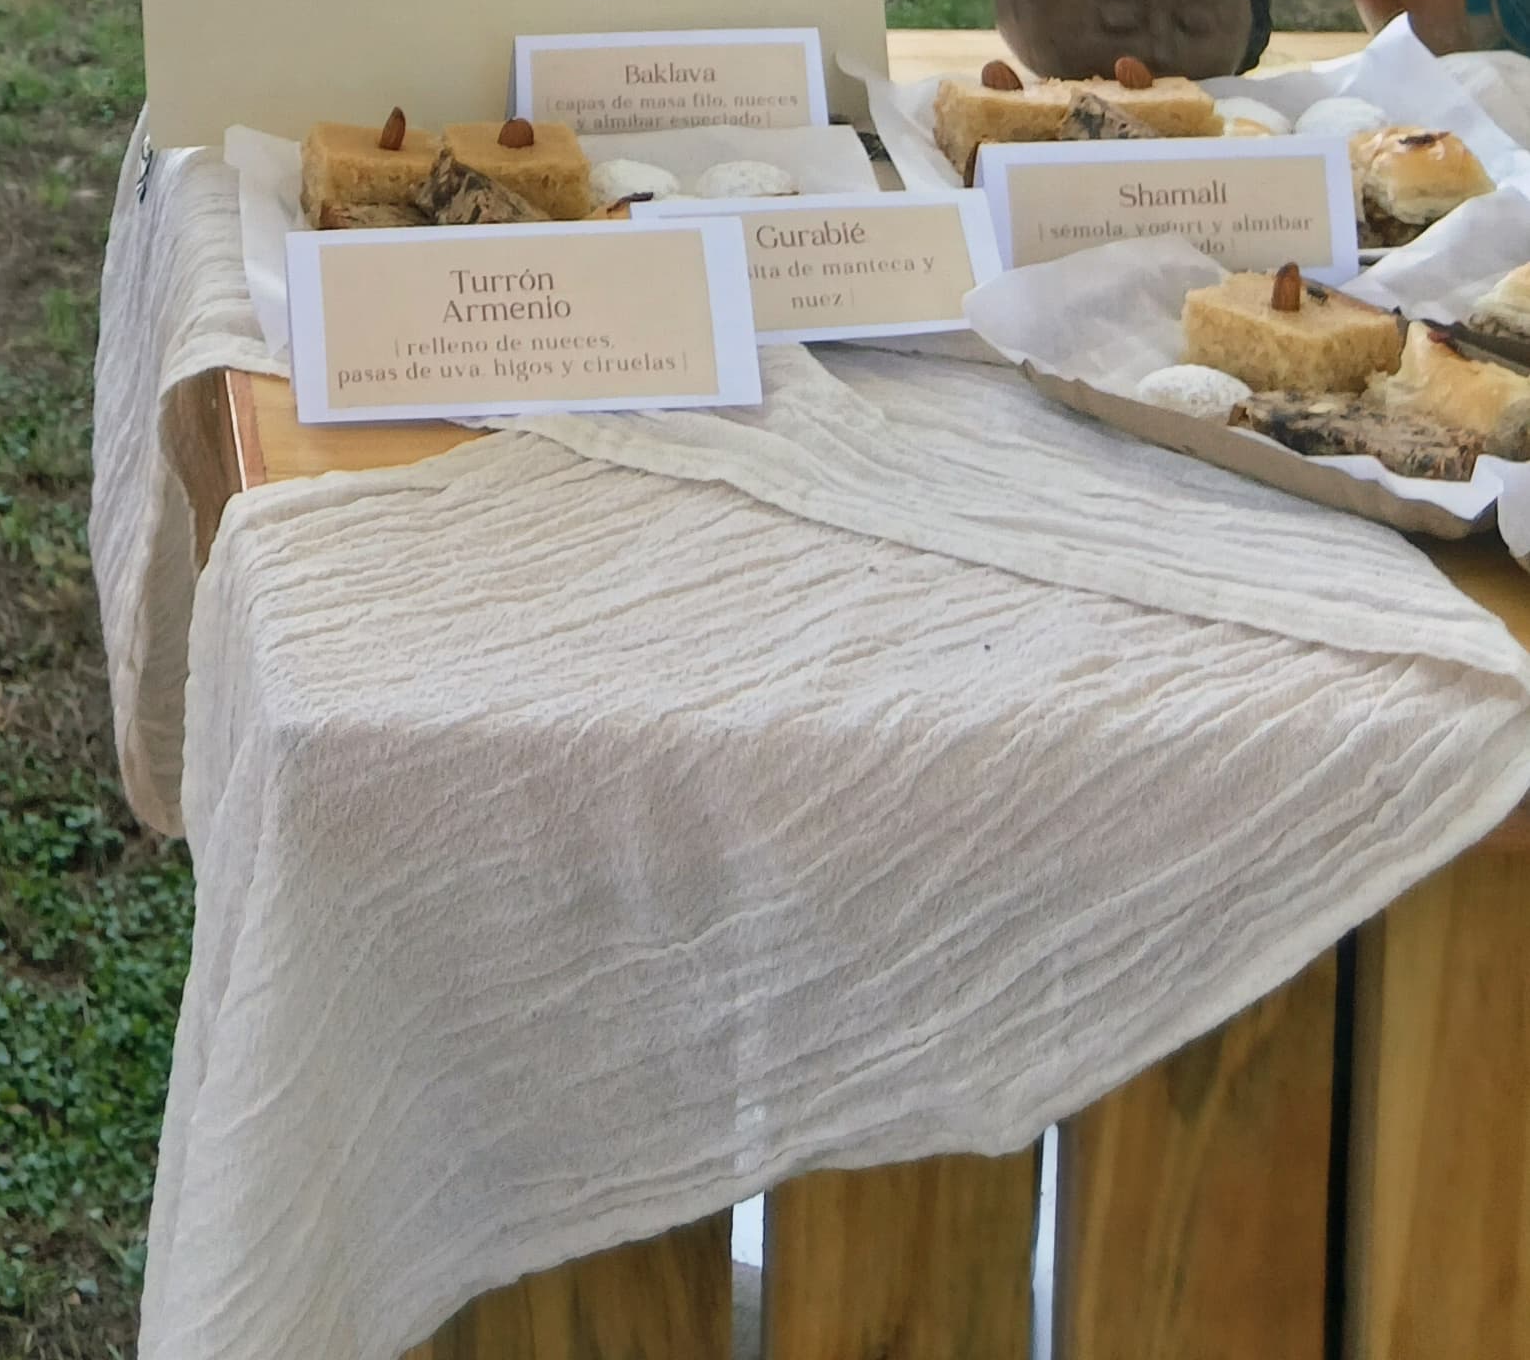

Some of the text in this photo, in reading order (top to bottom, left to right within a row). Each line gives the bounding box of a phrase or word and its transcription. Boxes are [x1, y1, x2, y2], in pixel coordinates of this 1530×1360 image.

[625, 62, 716, 85] Baklava
[612, 95, 633, 109] de
[640, 96, 686, 109] masa
[733, 93, 798, 108] nueces
[787, 260, 813, 278] de
[822, 259, 915, 276] manteca
[922, 256, 935, 273] y
[449, 268, 555, 295] Turrón
[442, 295, 572, 323] Armenio
[792, 292, 844, 309] nuez
[407, 337, 488, 356] relleno
[496, 334, 522, 353] de
[337, 365, 398, 389] pasas
[406, 362, 432, 380] de
[494, 356, 553, 382] higos
[561, 359, 575, 377] y
[583, 352, 676, 373] ciruelas
